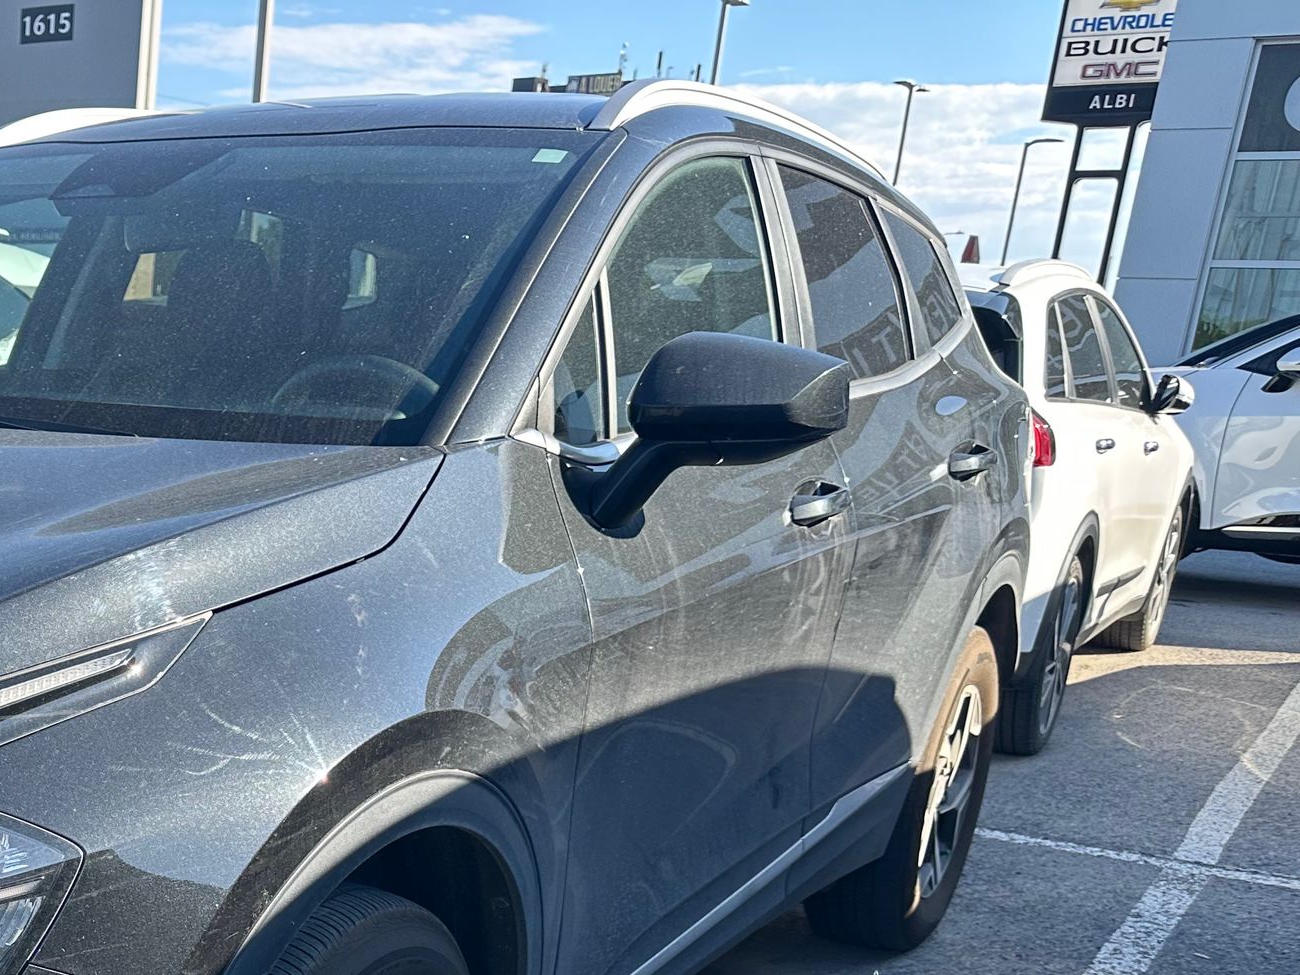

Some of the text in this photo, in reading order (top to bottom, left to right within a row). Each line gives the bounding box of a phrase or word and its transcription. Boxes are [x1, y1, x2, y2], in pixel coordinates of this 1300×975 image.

[22, 12, 71, 36] 1615
[1070, 12, 1174, 33] CHEVROLE
[1080, 60, 1159, 80] GMC
[1088, 93, 1136, 110] ALBI
